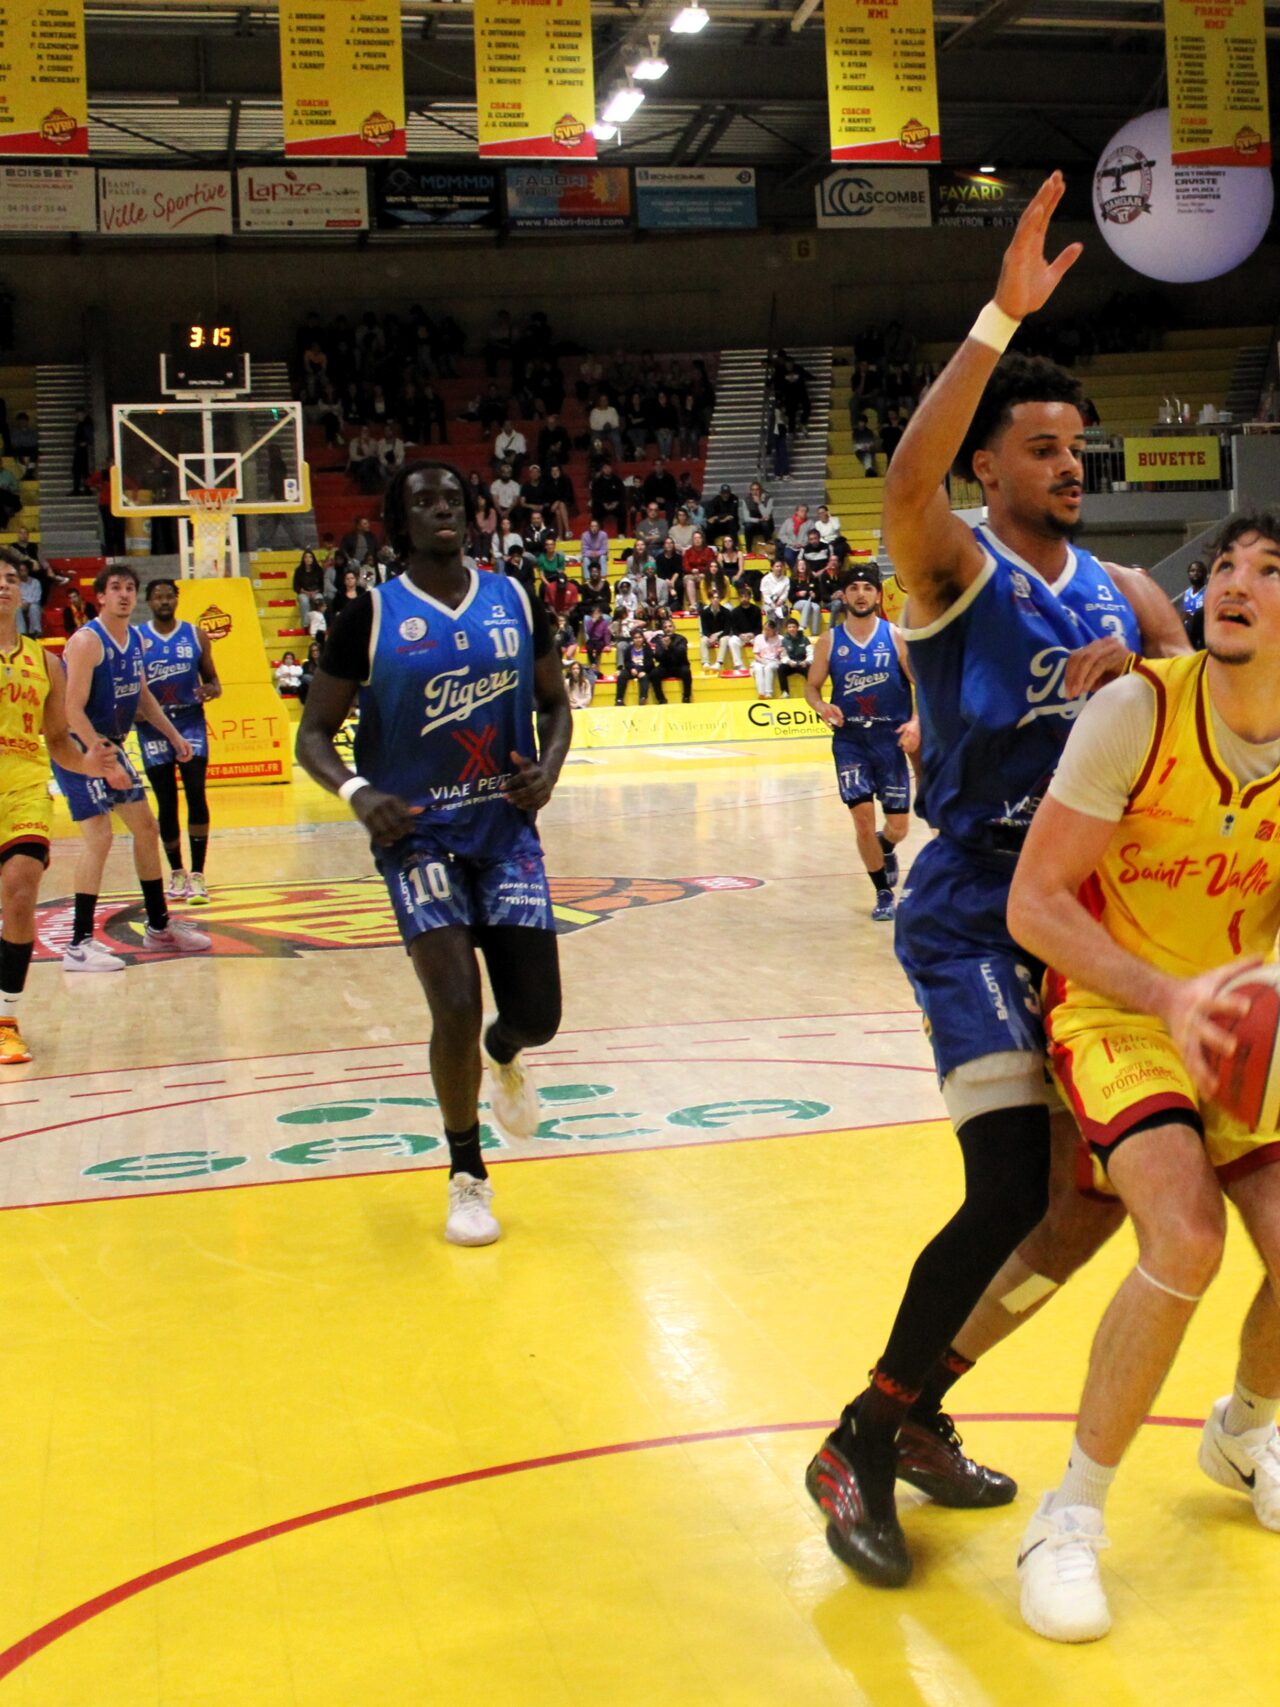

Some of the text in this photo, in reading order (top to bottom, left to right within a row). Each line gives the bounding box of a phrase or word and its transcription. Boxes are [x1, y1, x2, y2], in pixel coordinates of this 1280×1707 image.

[849, 190, 926, 204] LASCOMBE
[938, 185, 1004, 201] FAYARD
[103, 182, 228, 231] Ville Sportive
[1137, 448, 1206, 469] BUVETTE
[176, 646, 194, 660] 98
[487, 627, 520, 659] 10
[872, 652, 891, 668] 77
[147, 659, 192, 685] Tigers
[843, 669, 890, 696] Tigers
[421, 664, 520, 732] Tigers
[774, 726, 828, 736] Delmonico
[840, 768, 860, 790] 77
[429, 782, 471, 800] VIAE
[408, 861, 453, 906] 10
[980, 962, 1009, 1022] BALOTTI
